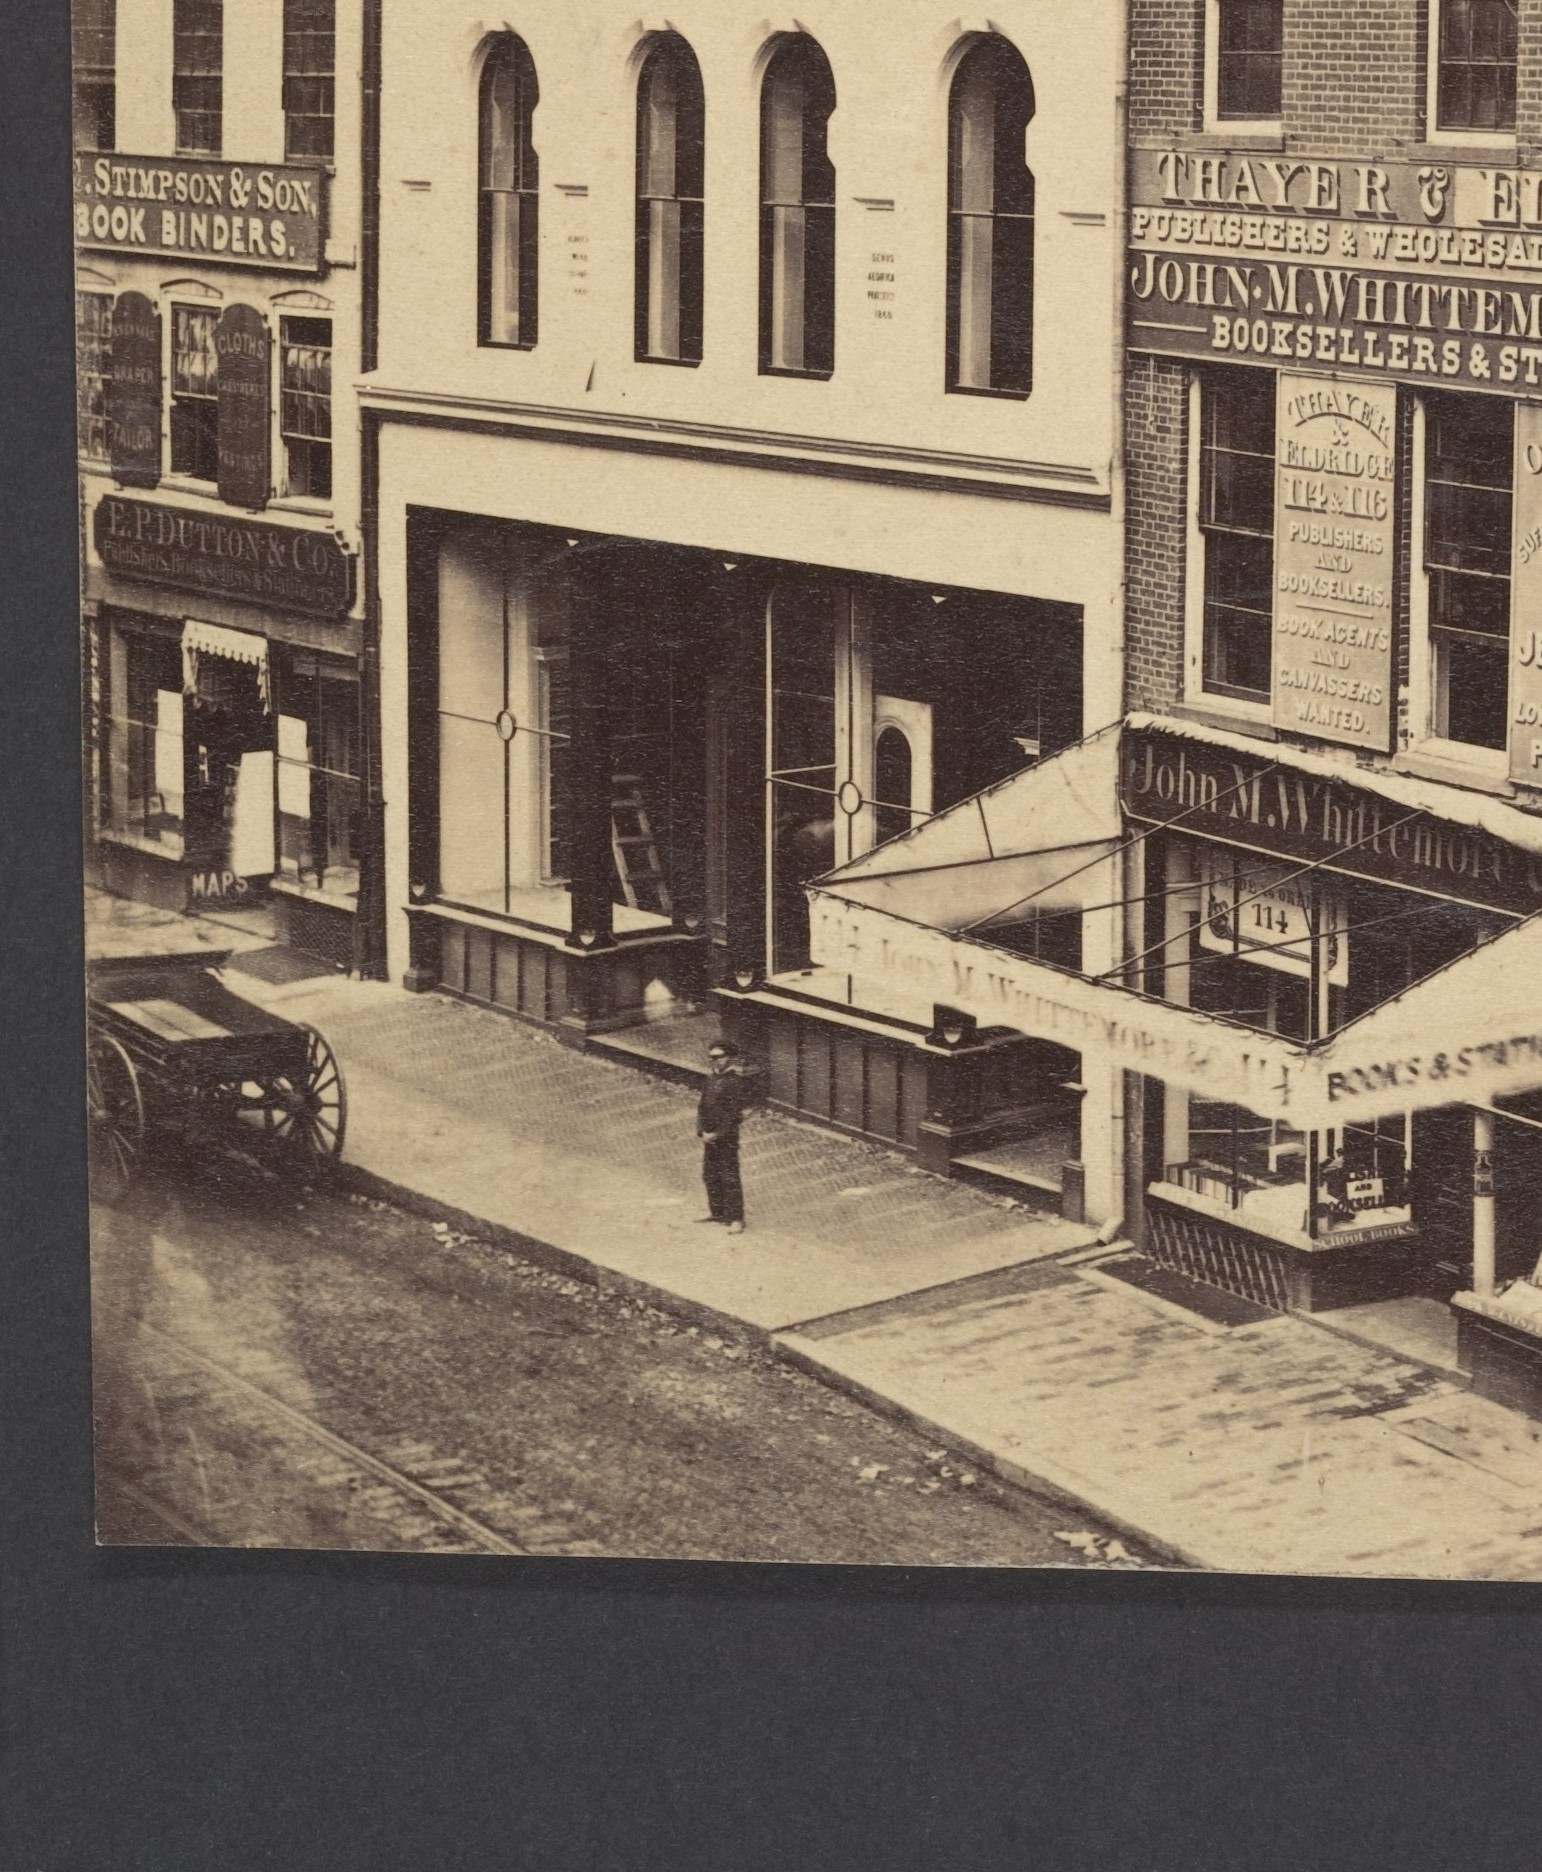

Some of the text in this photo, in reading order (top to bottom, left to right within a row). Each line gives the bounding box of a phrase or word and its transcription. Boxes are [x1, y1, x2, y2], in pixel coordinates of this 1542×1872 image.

[230, 167, 251, 209] &
[1158, 152, 1399, 221] THAYER
[1418, 166, 1450, 224] &
[76, 202, 295, 258] BOOK BINDERS.
[1131, 208, 1331, 256] PUBLISHERS
[1339, 225, 1358, 258] &
[217, 332, 266, 361] CLOTHS
[1213, 316, 1464, 378] BOOKSELLERS
[1468, 348, 1492, 377] &
[1287, 389, 1391, 449] THAYER
[1331, 418, 1350, 446] &
[1280, 438, 1394, 482] ELDRIDGE
[1284, 478, 1388, 521] 114 & 116
[1290, 521, 1384, 555] PUBLISHERS
[1314, 551, 1353, 574] AND
[1278, 570, 1391, 610] BOOKSELLERS.
[1277, 615, 1389, 653] BOOK AGENTS
[1311, 646, 1351, 671] AND
[1279, 669, 1383, 707] CANVASSERS
[1296, 698, 1373, 736] WANTED.
[1128, 743, 1218, 812] John
[1229, 763, 1275, 827] M.
[191, 871, 249, 898] MAPS
[1251, 903, 1289, 935] 114
